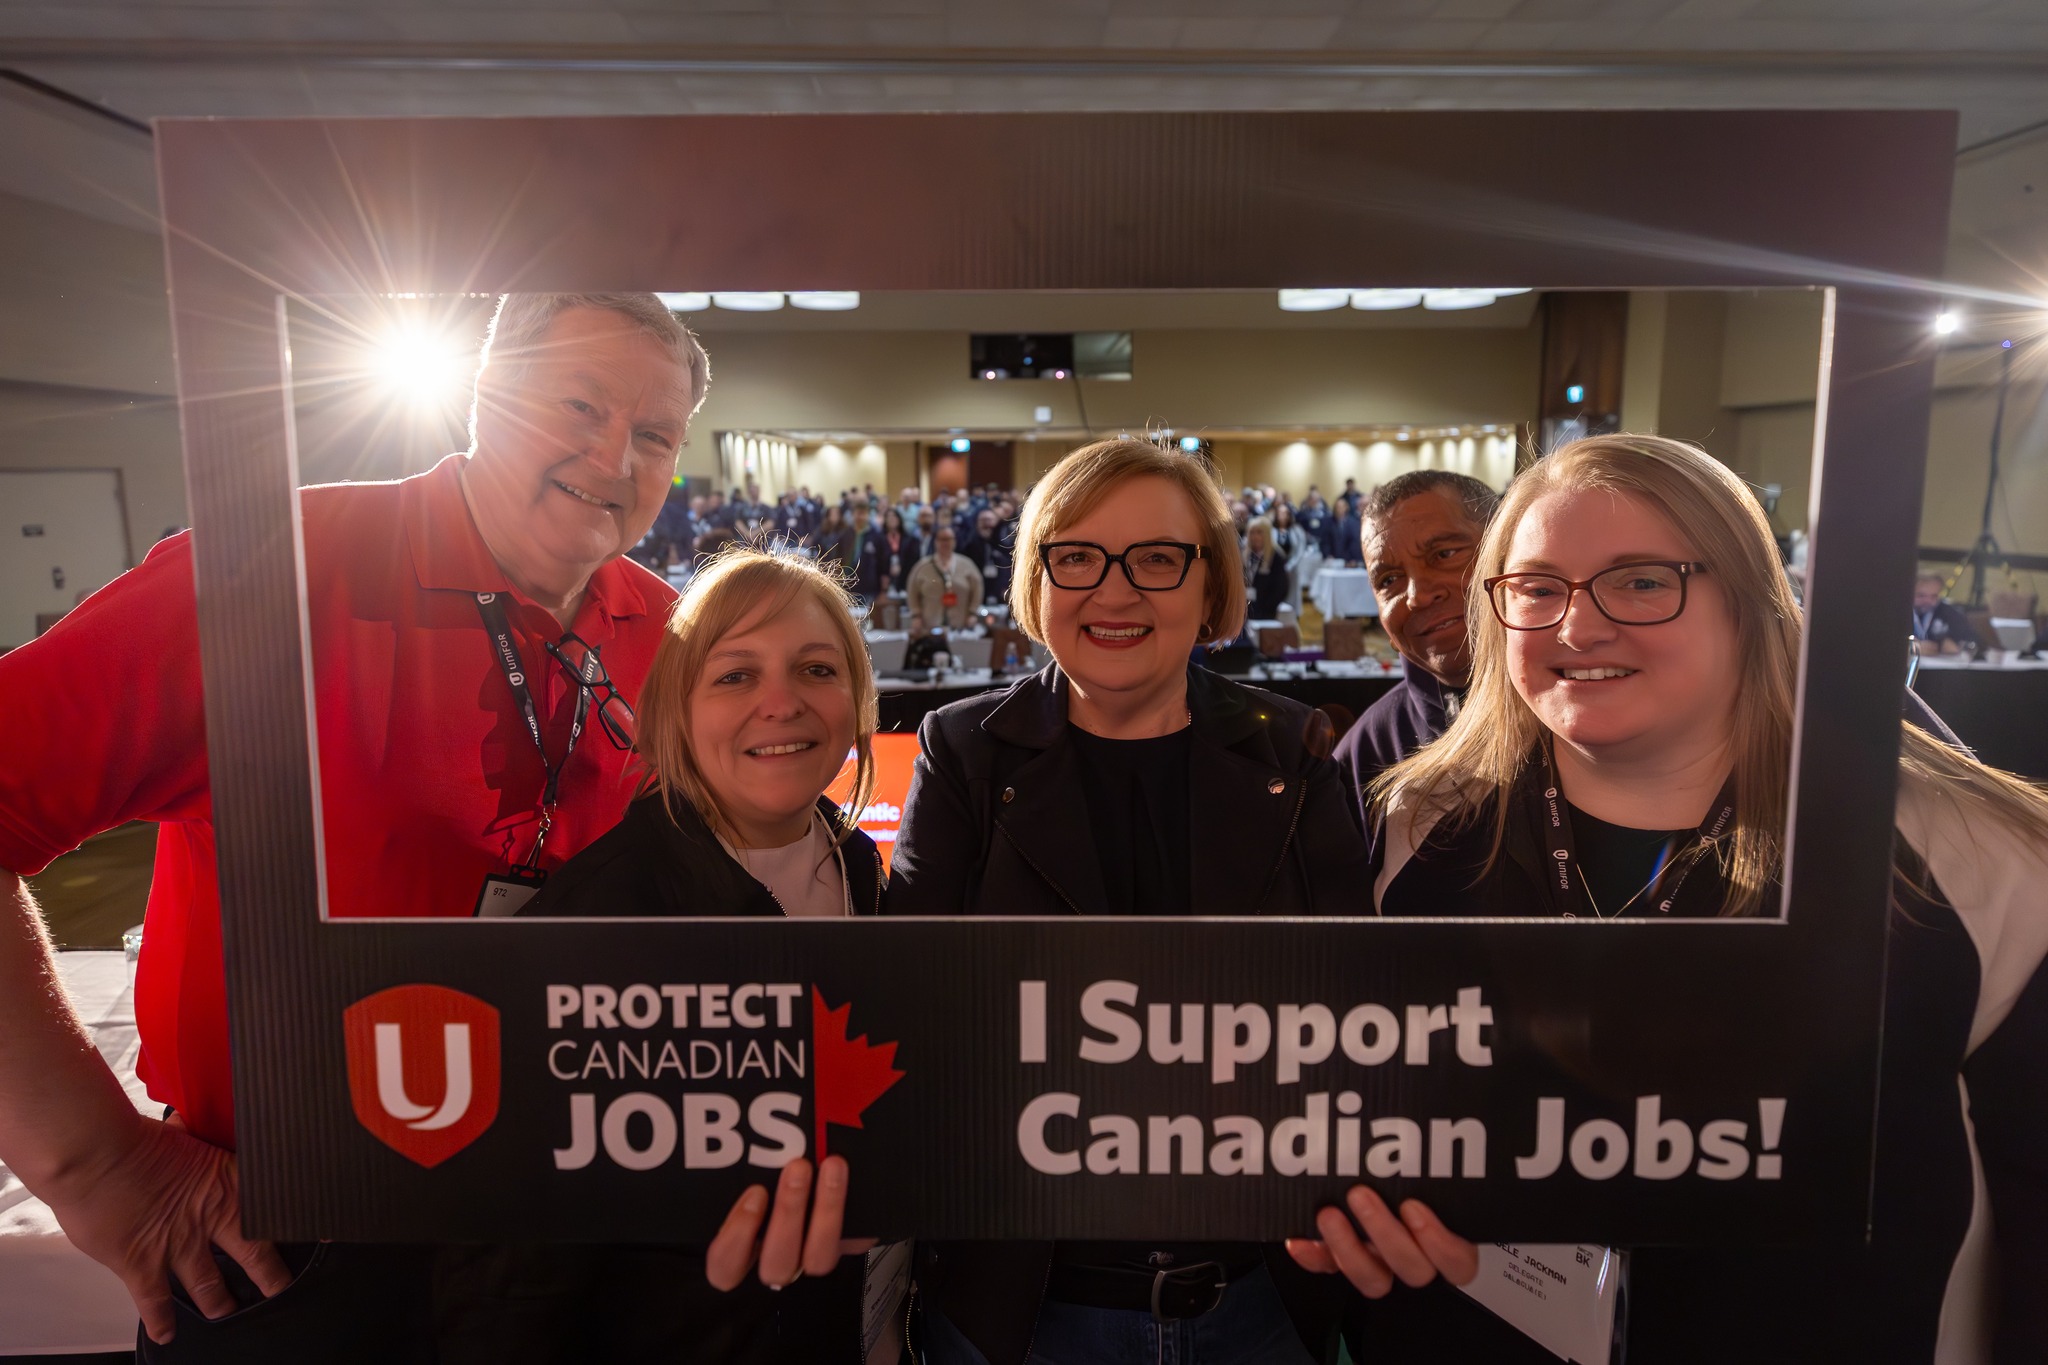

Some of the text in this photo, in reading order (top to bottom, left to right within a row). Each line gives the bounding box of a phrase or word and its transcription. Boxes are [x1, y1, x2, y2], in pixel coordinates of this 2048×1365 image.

[498, 633, 517, 670] UNIFOR
[1549, 799, 1561, 827] UNIFOR
[1711, 806, 1733, 836] UNIFOR
[493, 887, 508, 897] 972
[1558, 861, 1569, 890] UNIFOR
[547, 985, 802, 1028] PROTECT
[1020, 980, 1494, 1085] I Support
[375, 1023, 472, 1130] U
[548, 1041, 804, 1079] CANADIAN
[554, 1092, 806, 1170] JOBS
[1018, 1091, 1786, 1179] Canadian Jobs!
[1508, 1262, 1544, 1288] DELEGATE
[1524, 1256, 1567, 1286] JACKMAN
[1576, 1252, 1590, 1268] BK
